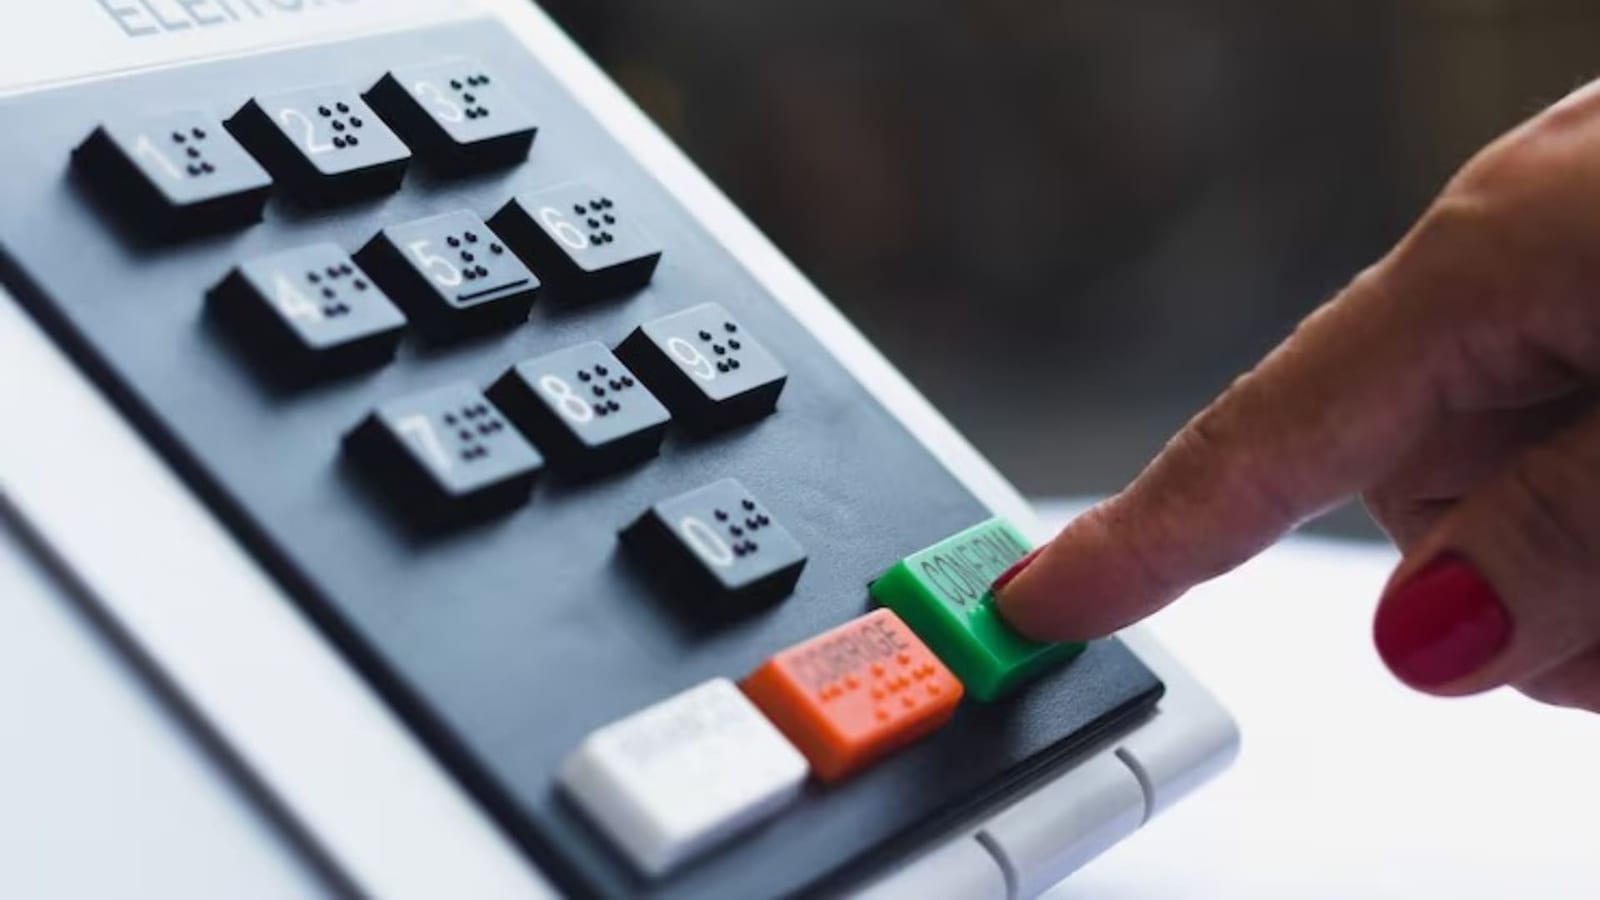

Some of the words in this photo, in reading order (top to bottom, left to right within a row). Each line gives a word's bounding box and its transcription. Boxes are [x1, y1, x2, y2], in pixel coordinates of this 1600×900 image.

[415, 80, 463, 123] 3
[279, 108, 340, 155] 2
[136, 134, 184, 181] 1
[539, 206, 589, 250] 6
[409, 239, 462, 287] 5
[274, 271, 322, 323] 4
[667, 337, 716, 381] 9
[539, 375, 595, 423] 8
[399, 413, 450, 468] 7
[680, 516, 736, 567] 0
[788, 618, 909, 690] CORRIGE
